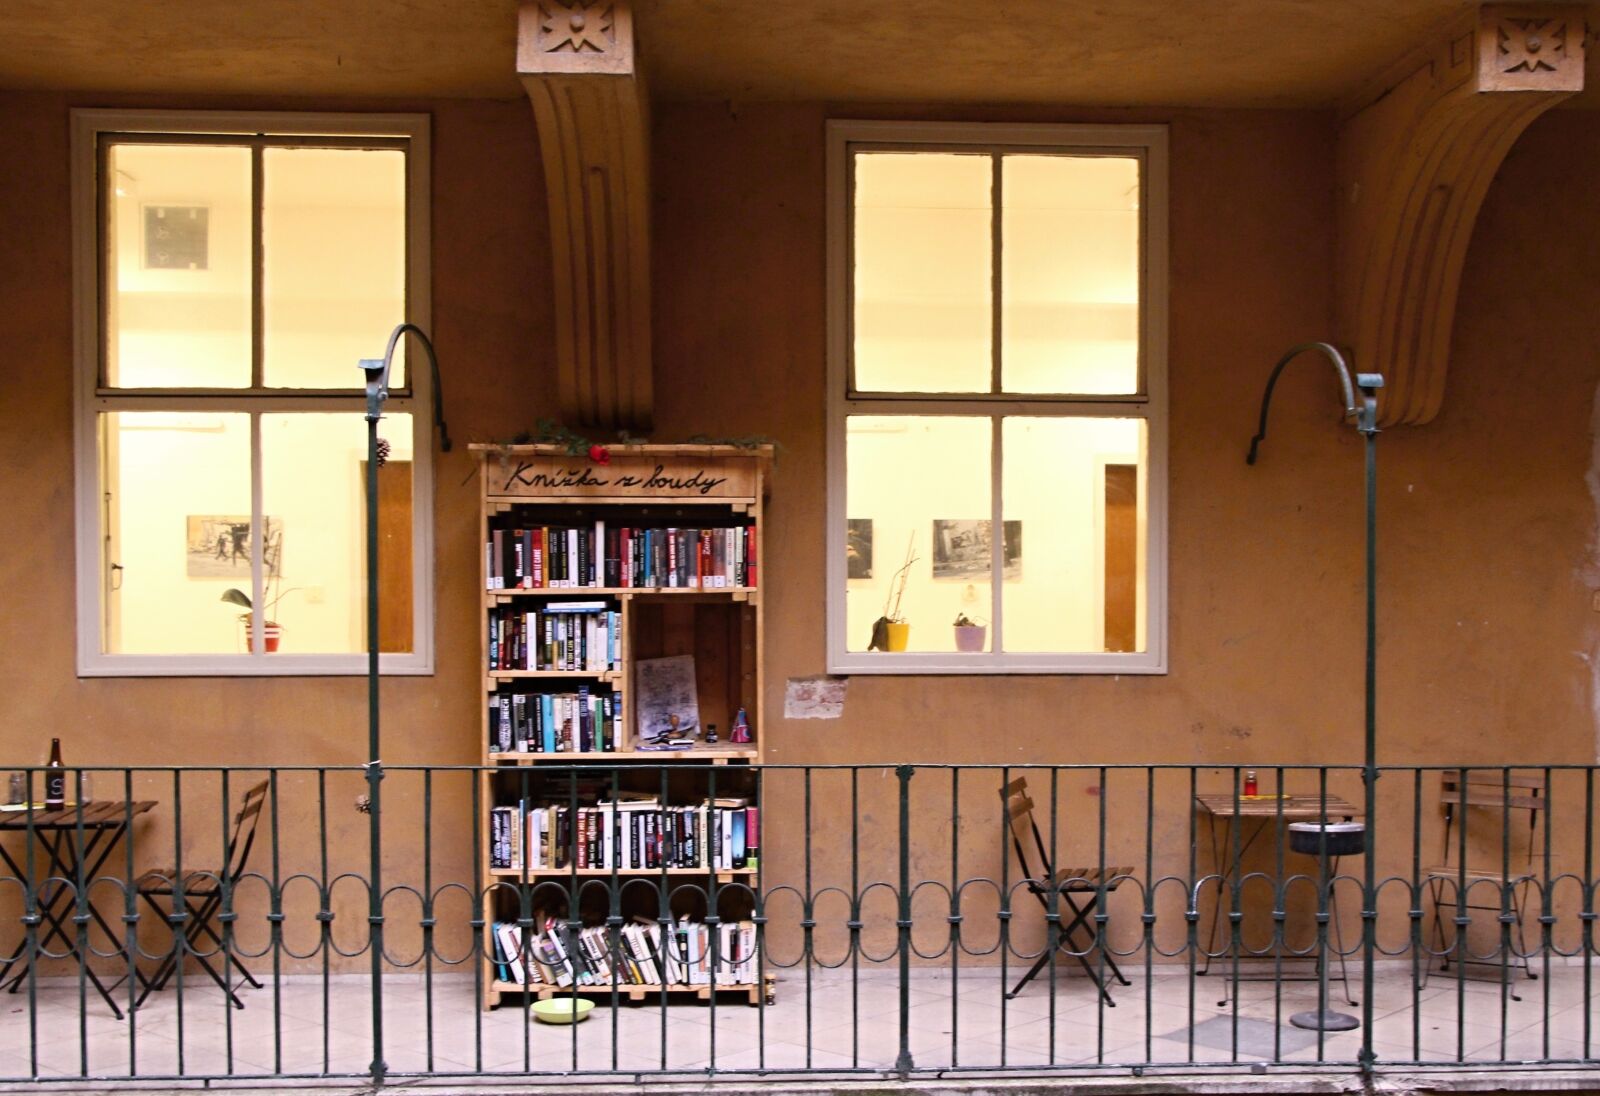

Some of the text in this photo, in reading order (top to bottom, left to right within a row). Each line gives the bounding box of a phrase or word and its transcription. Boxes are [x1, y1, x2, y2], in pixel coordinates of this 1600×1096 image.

[504, 461, 727, 494] Knížka z boudy
